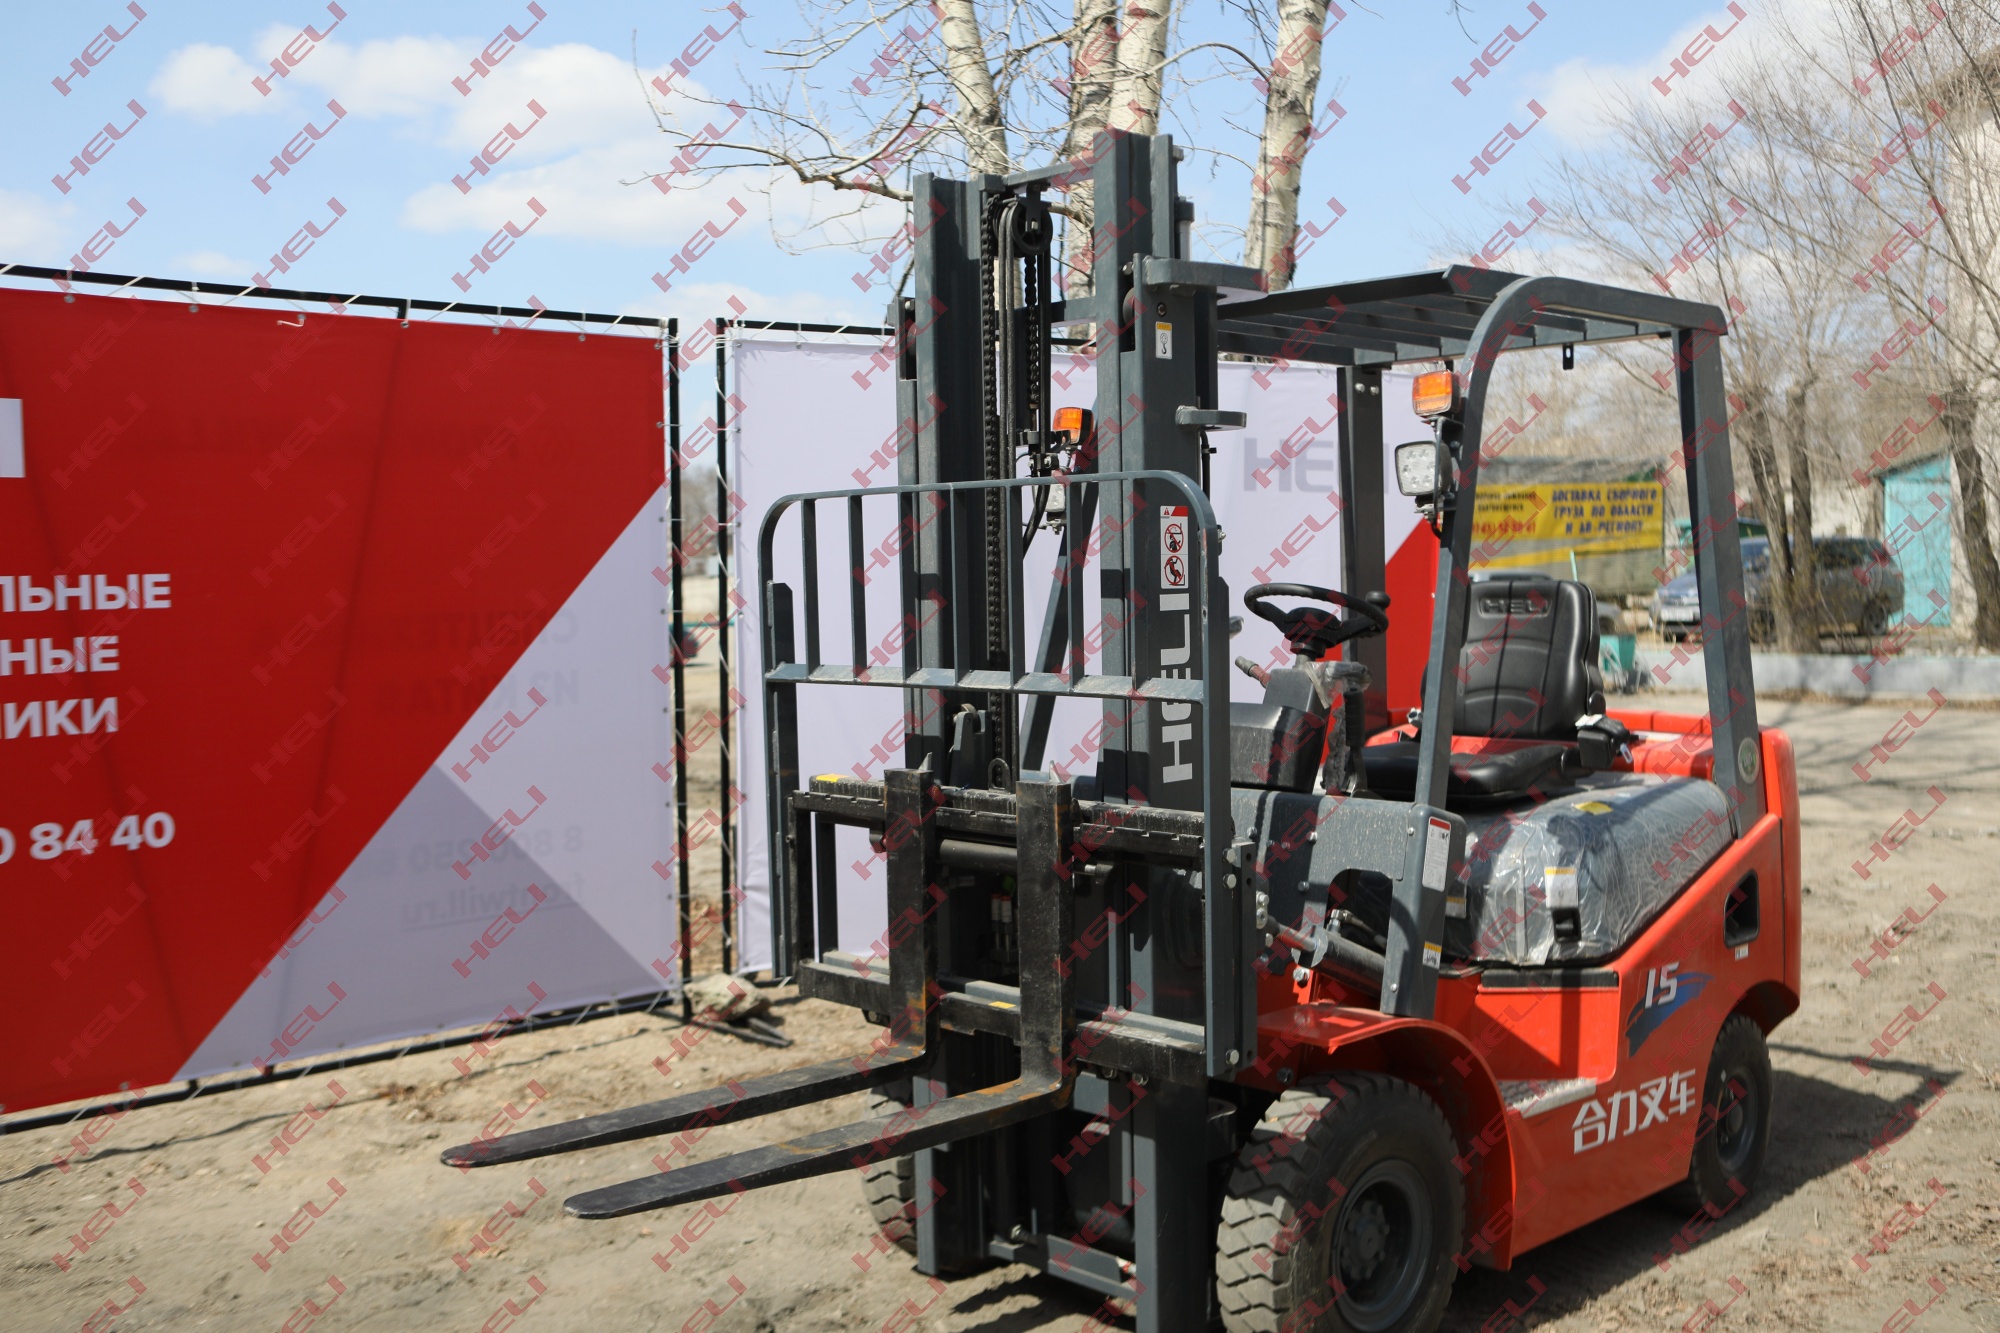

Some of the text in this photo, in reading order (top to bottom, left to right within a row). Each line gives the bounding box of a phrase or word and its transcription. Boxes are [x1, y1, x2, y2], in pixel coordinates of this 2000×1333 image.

[1159, 593, 1193, 783] HELI
[0, 697, 119, 740] ИКИ
[29, 818, 98, 861] 84
[110, 811, 176, 851] 40
[1644, 961, 1680, 1009] 15
[1572, 1068, 1696, 1155] 合力叉车
